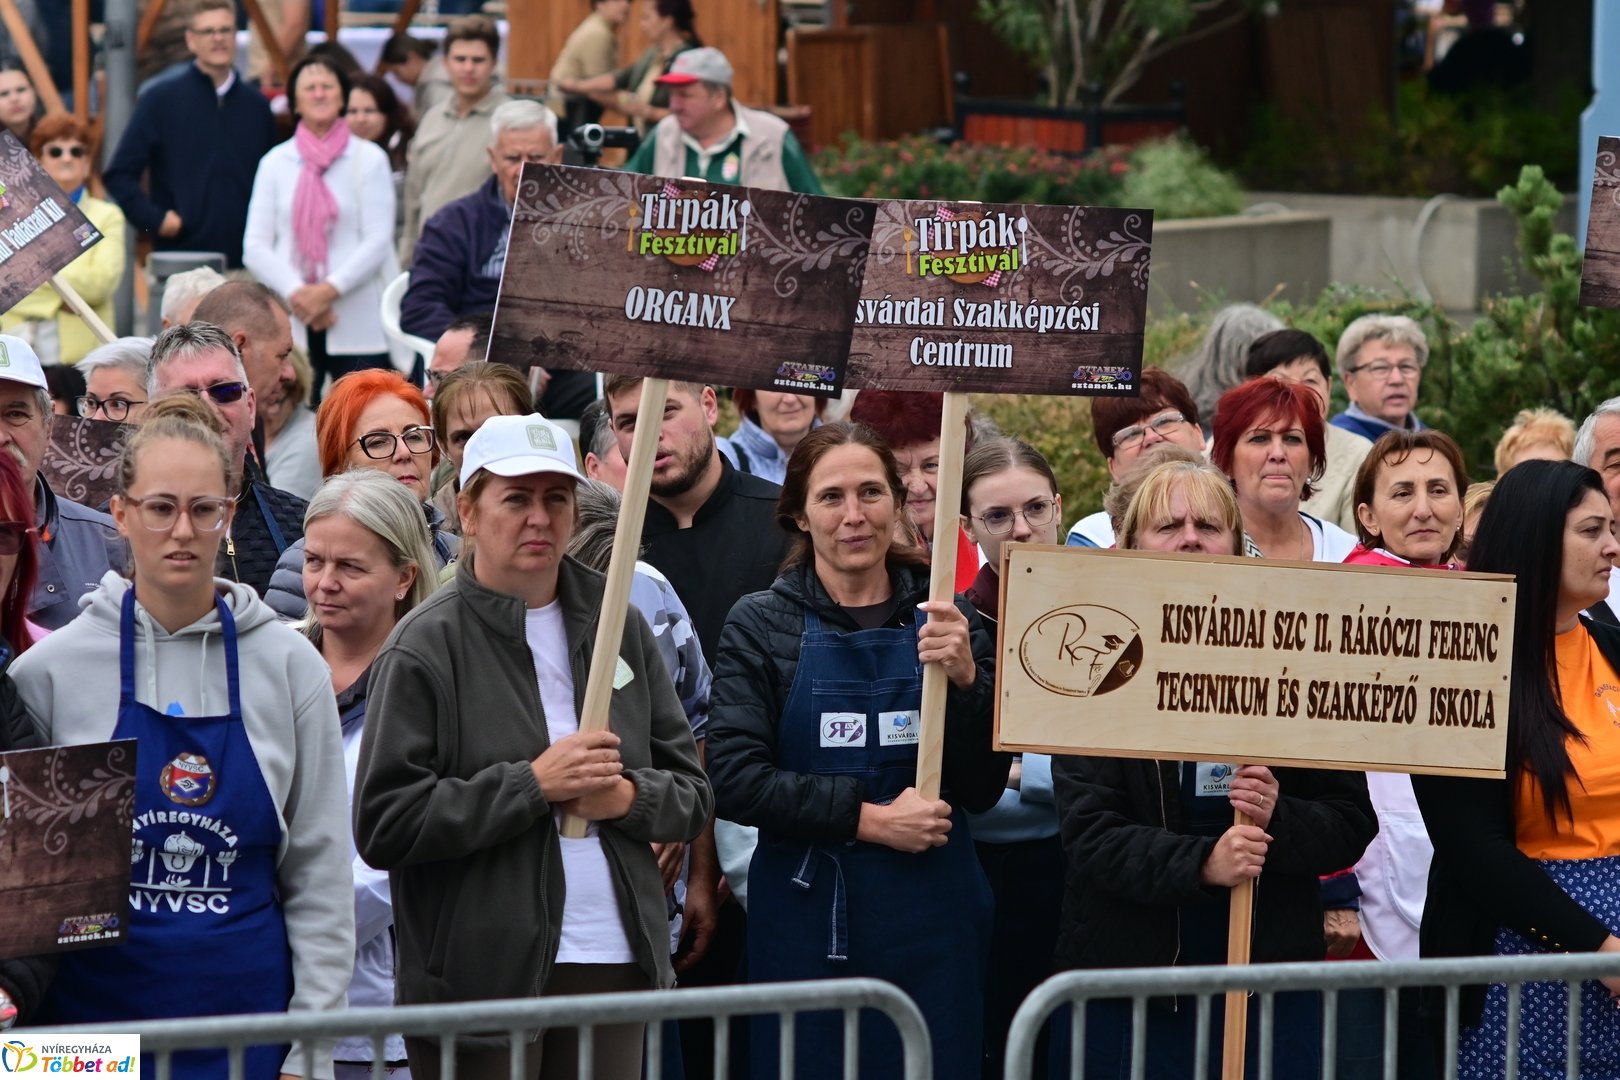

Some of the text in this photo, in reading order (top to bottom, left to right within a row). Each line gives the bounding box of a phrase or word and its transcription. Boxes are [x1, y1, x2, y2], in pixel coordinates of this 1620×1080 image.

[639, 231, 738, 255] Fesztivál
[919, 248, 1018, 277] Fesztivál
[625, 285, 736, 330] ORGANX
[855, 294, 1100, 333] svárdai Szakképzési
[909, 336, 1013, 368] Centrum
[774, 378, 834, 391] sztanek.hu
[1071, 382, 1132, 390] sztanek.hu
[1161, 595, 1499, 663] KISVÁRDAI SZC II. RÁKÓCZI FERENC
[1157, 667, 1496, 729] TECHNIKUM ÉS SZAKKÉPZŐ ISKOLA
[178, 761, 206, 773] NYVSC
[132, 809, 239, 848] NYÍREGYHÁZA
[129, 890, 229, 914] NYVSC
[57, 930, 120, 944] sztanek.hu
